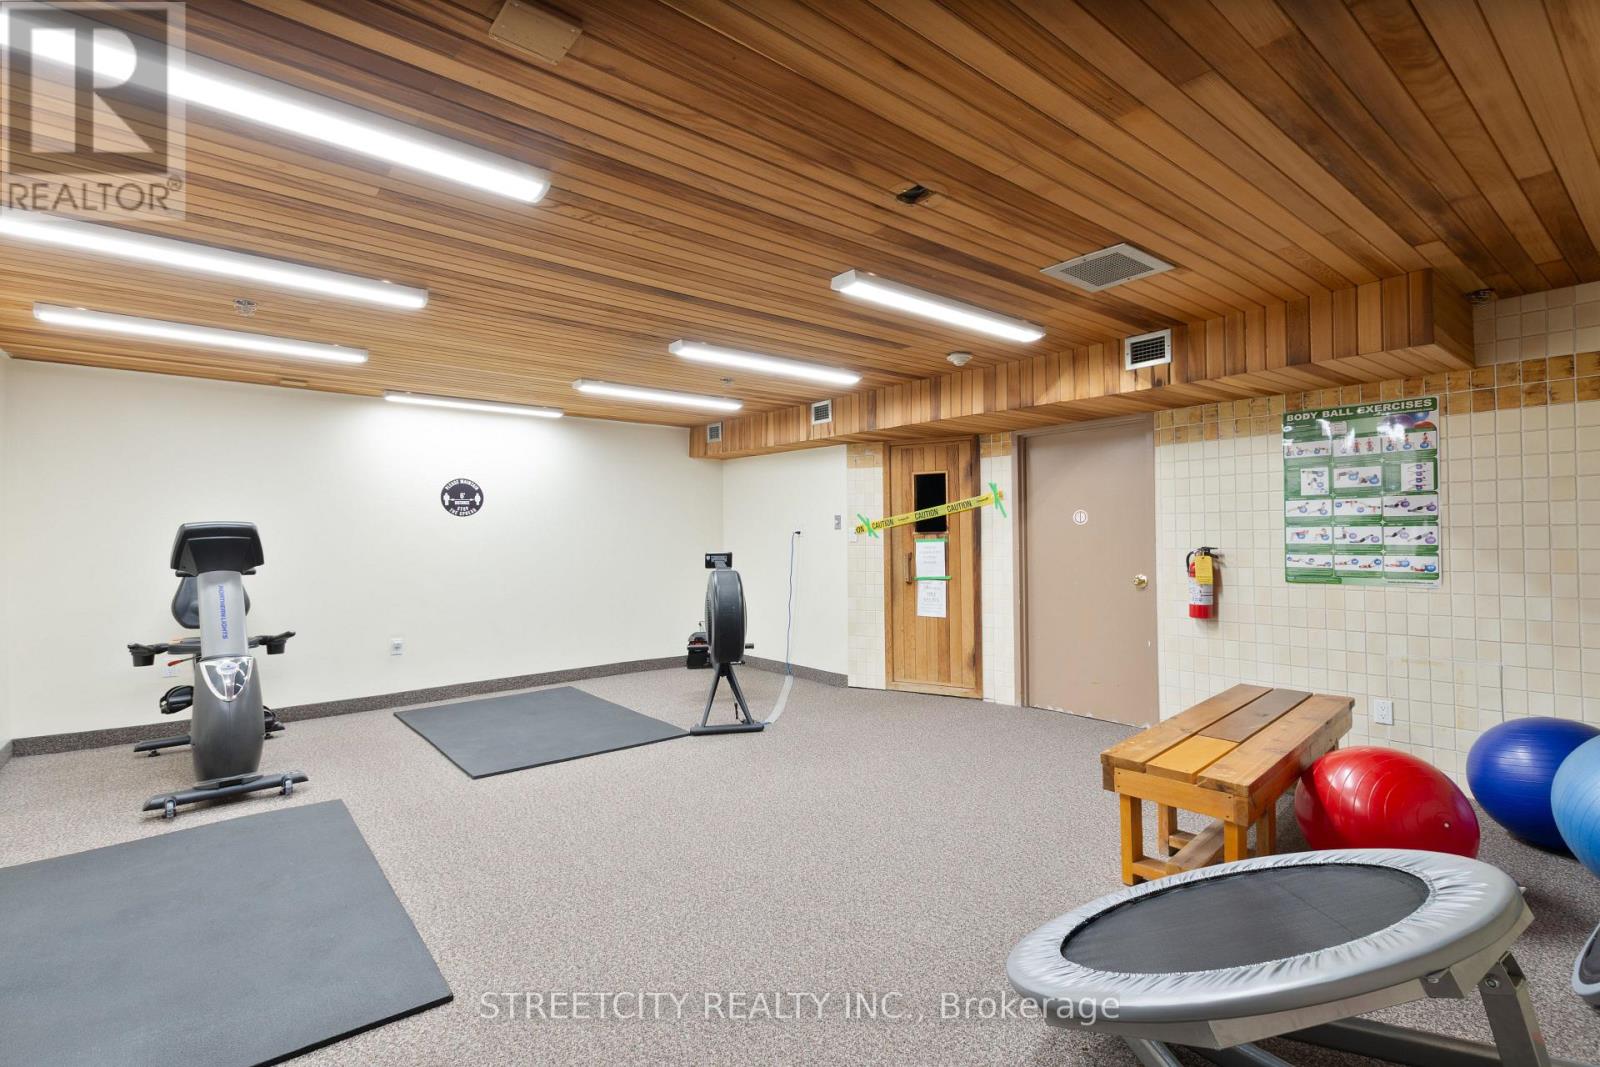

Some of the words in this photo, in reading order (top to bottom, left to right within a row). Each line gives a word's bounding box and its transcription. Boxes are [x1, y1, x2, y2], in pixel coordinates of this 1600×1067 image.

[1286, 411, 1318, 422] BODY
[1322, 408, 1354, 418] BALL
[1356, 399, 1432, 413] EXERCISES
[871, 518, 895, 530] CAUTION
[914, 508, 939, 521] CAUTION
[946, 499, 973, 513] CAUTION
